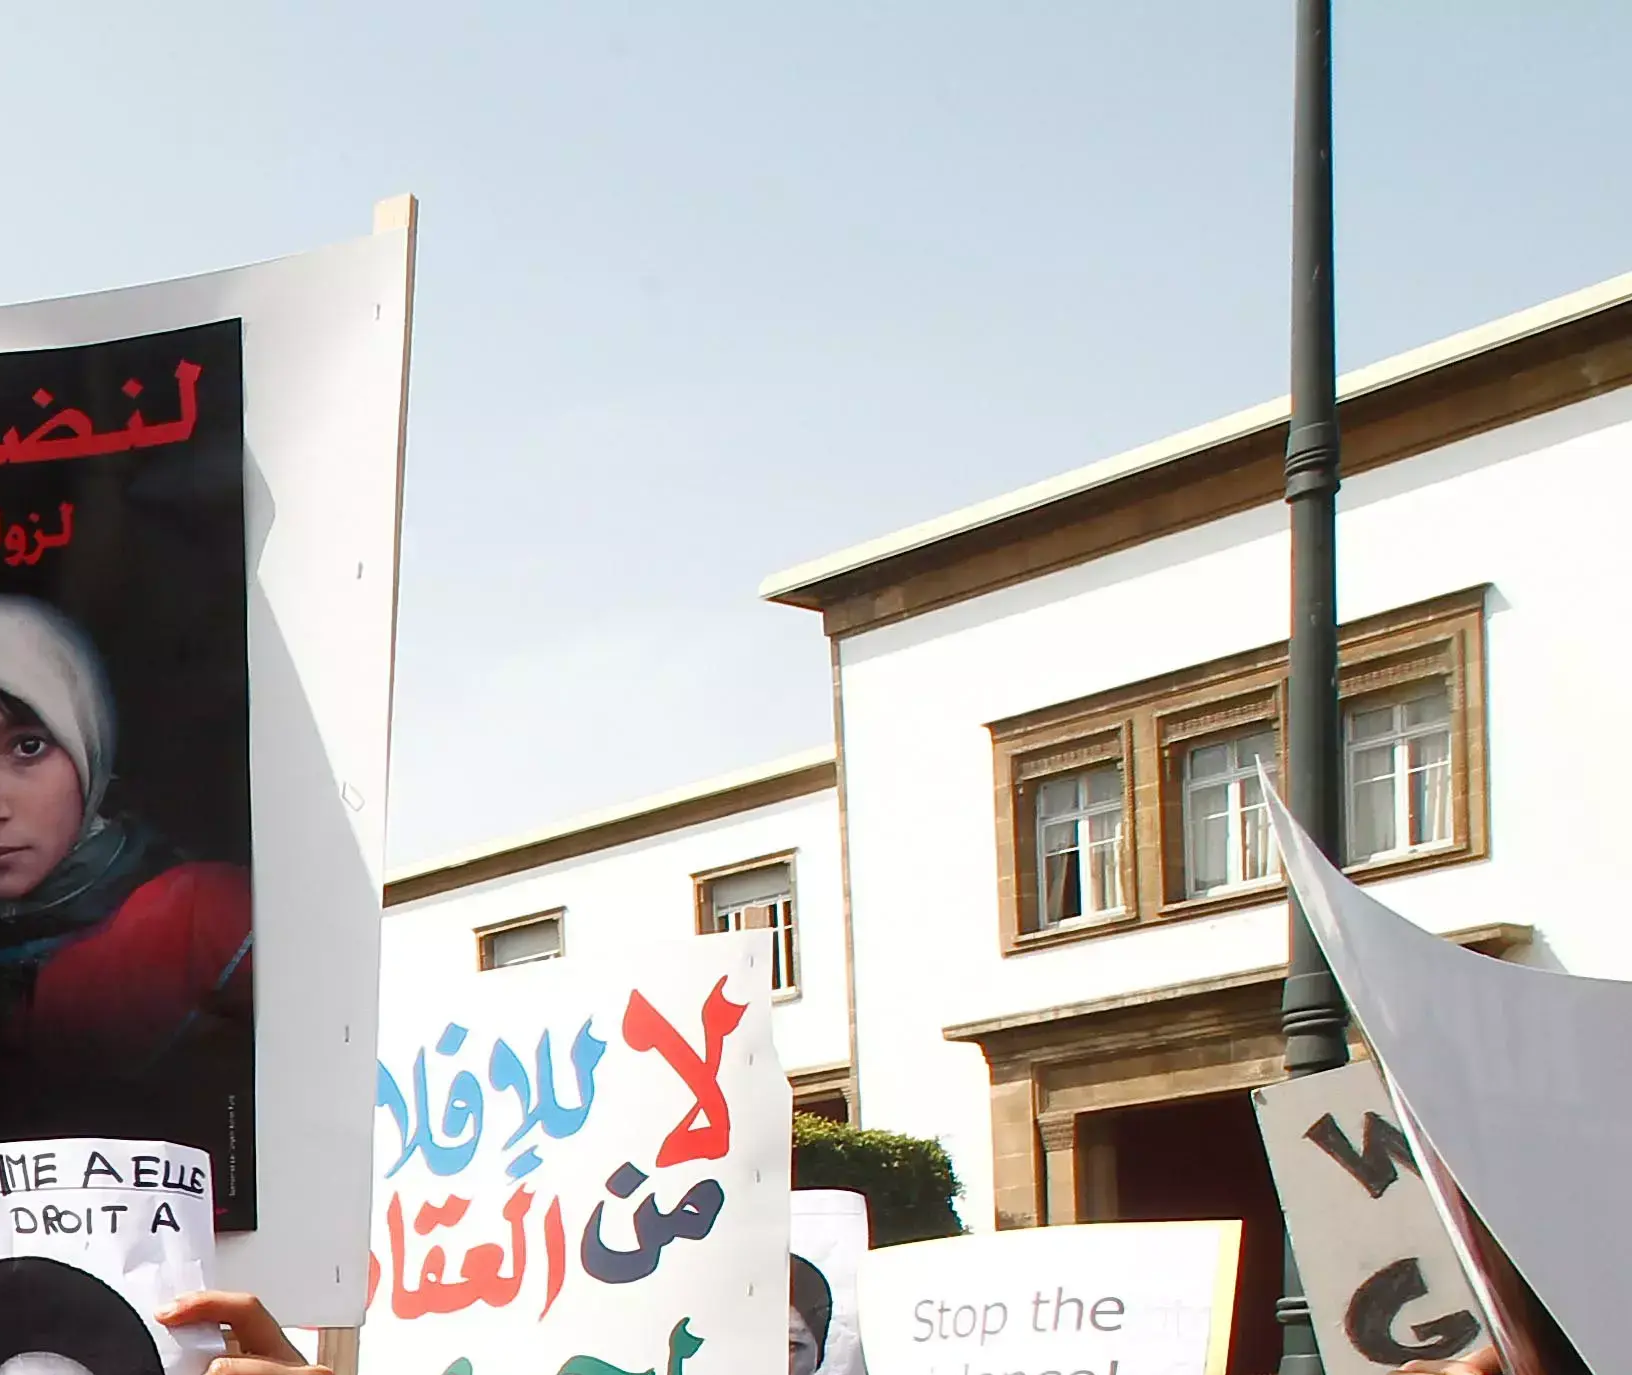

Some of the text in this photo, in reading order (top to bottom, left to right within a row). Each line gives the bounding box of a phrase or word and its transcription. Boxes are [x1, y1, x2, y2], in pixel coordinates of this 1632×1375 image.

[621, 974, 750, 1169] لا
[82, 1150, 124, 1189] A
[131, 1154, 207, 1196] ELLE
[11, 1204, 129, 1235] DROIT
[151, 1201, 181, 1234] A
[580, 1161, 726, 1284] من
[910, 1285, 1126, 1346] Stop the
